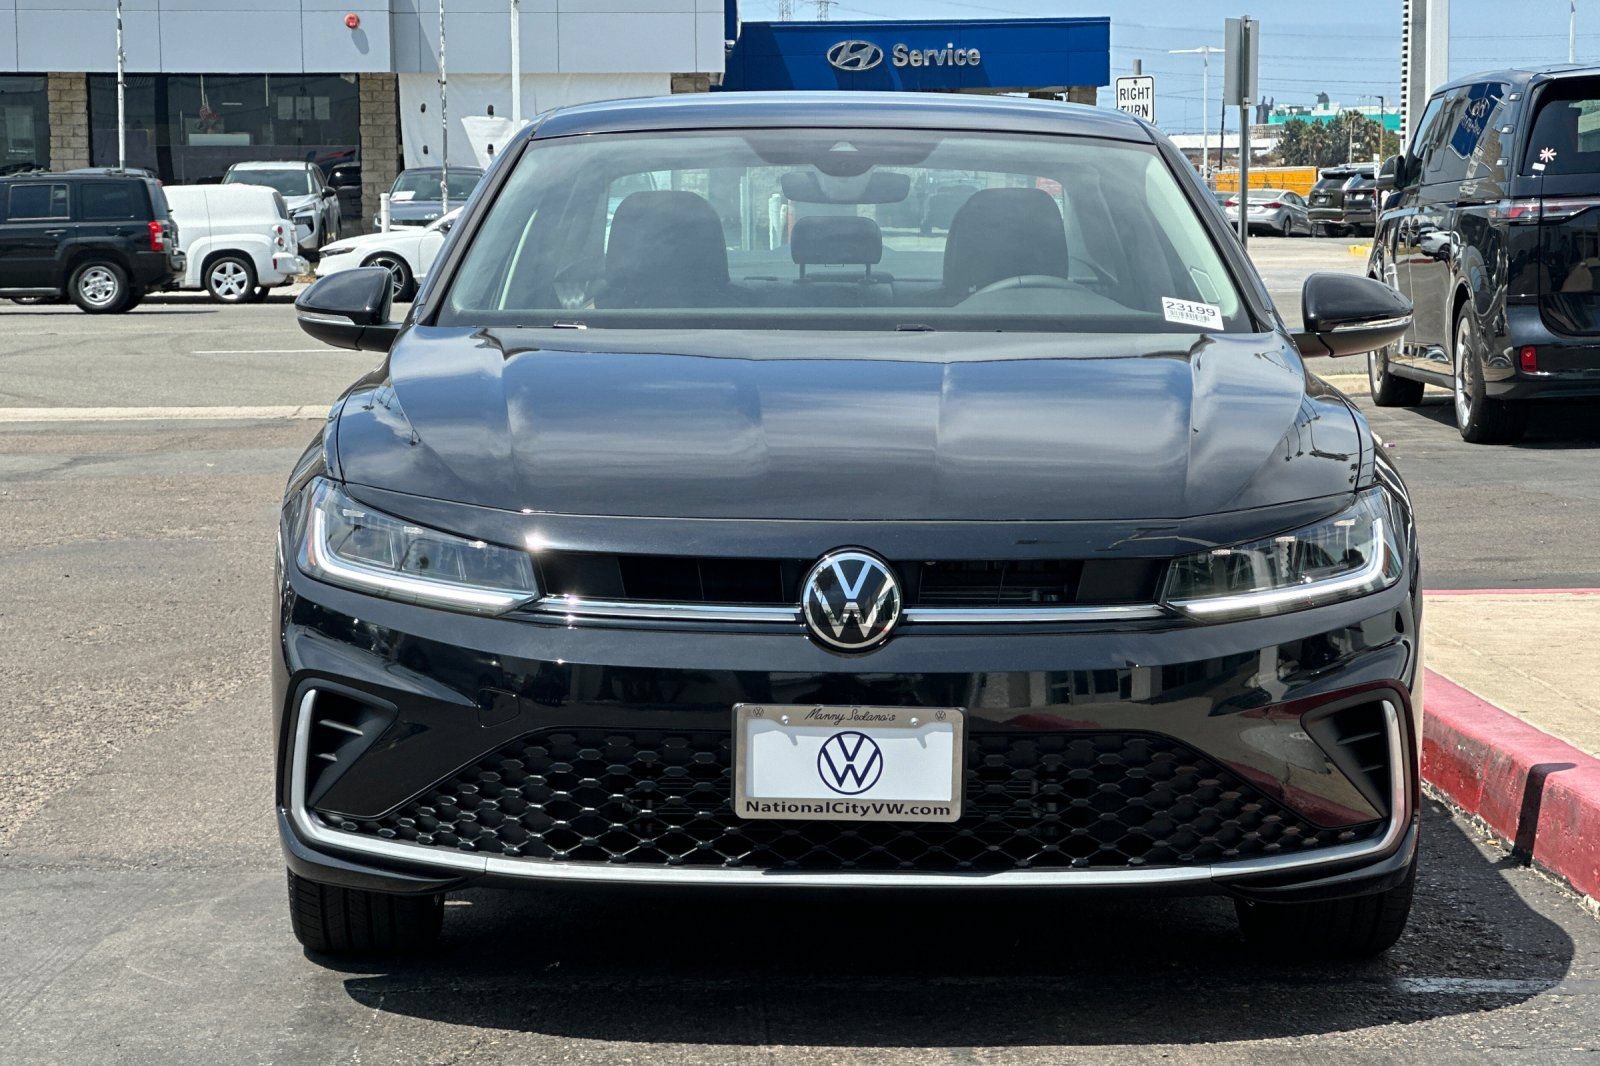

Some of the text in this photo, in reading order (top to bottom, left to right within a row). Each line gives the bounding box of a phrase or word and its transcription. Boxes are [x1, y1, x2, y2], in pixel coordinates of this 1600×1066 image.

[892, 43, 981, 67] Service
[1119, 87, 1150, 101] RIGHT
[1165, 302, 1216, 316] 23199
[804, 708, 846, 726] Manny
[745, 801, 952, 817] NationalCityVW.com
